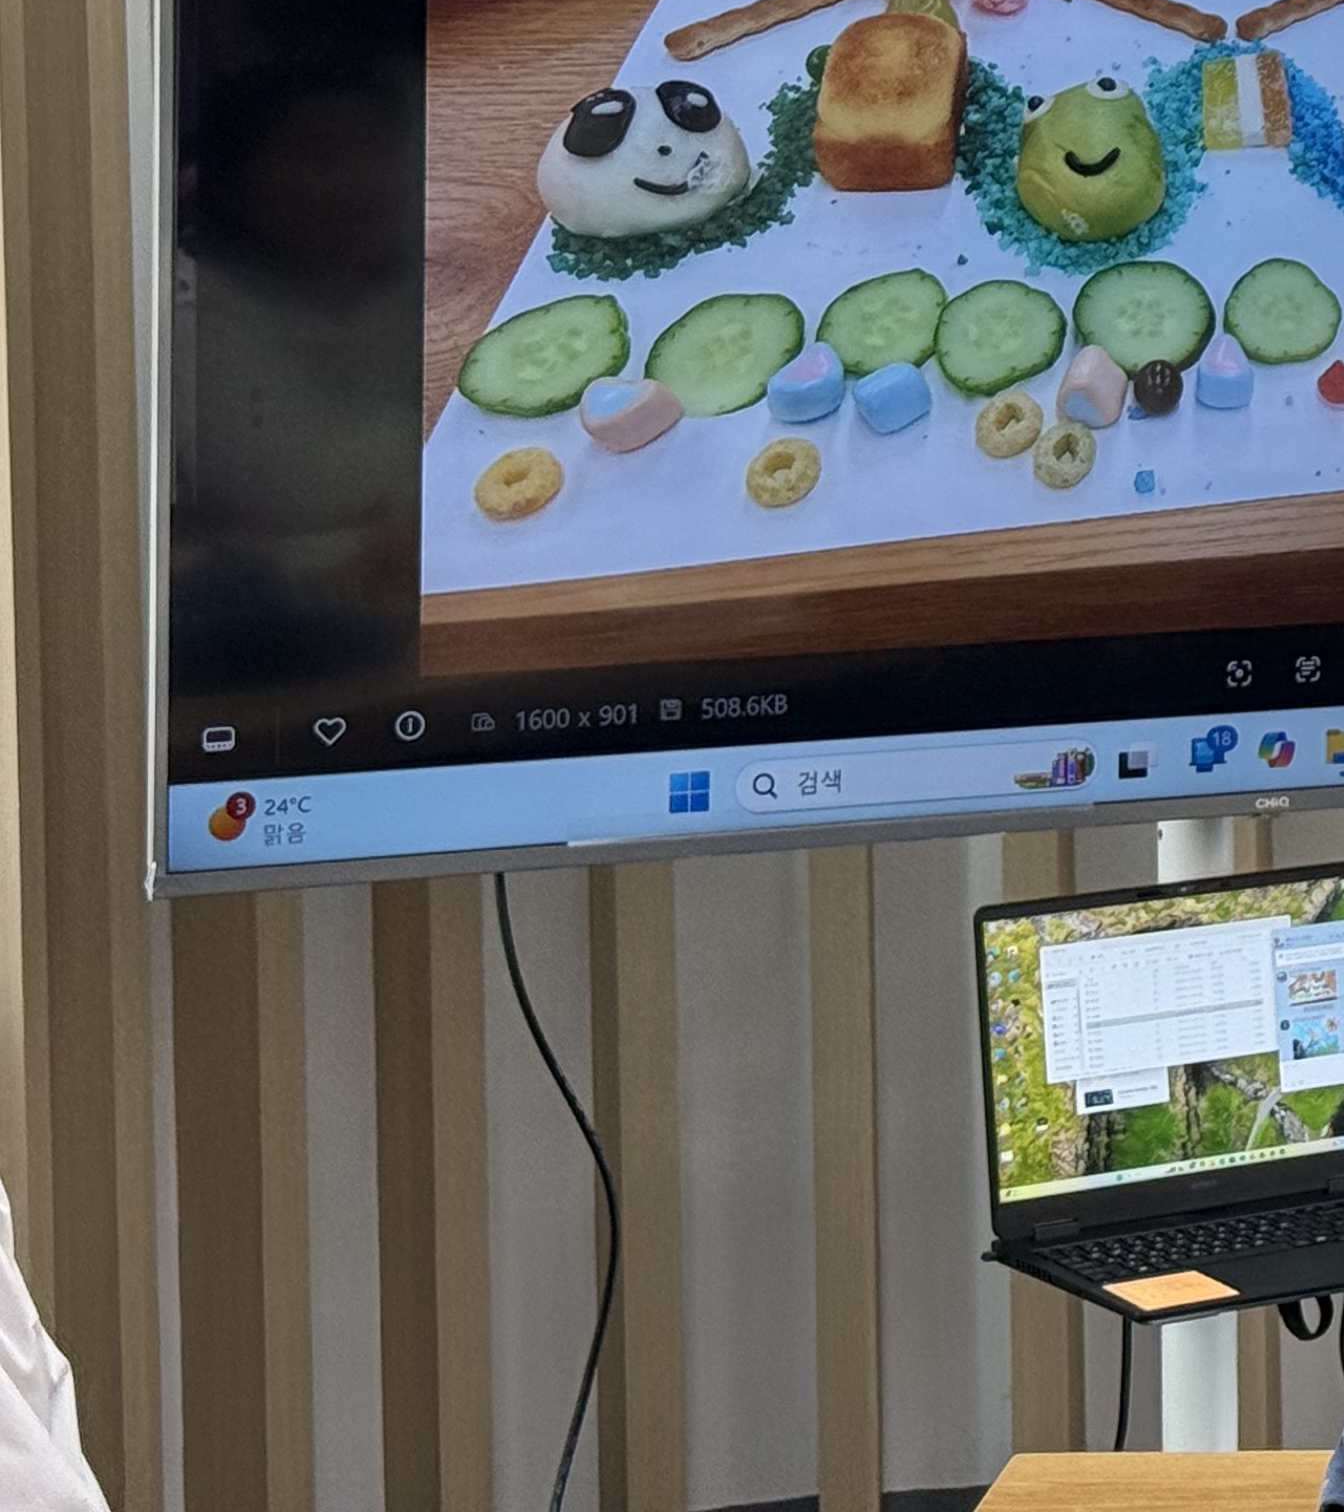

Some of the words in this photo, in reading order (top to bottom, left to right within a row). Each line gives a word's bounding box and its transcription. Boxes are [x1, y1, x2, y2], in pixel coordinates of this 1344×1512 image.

[516, 708, 571, 732] 1600
[599, 703, 638, 727] 901
[701, 694, 789, 720] 508.6KB
[1213, 730, 1232, 747] 18
[798, 769, 842, 796] 검색
[235, 797, 248, 815] 3
[264, 796, 312, 816] 24°C
[264, 822, 307, 846] 맑음
